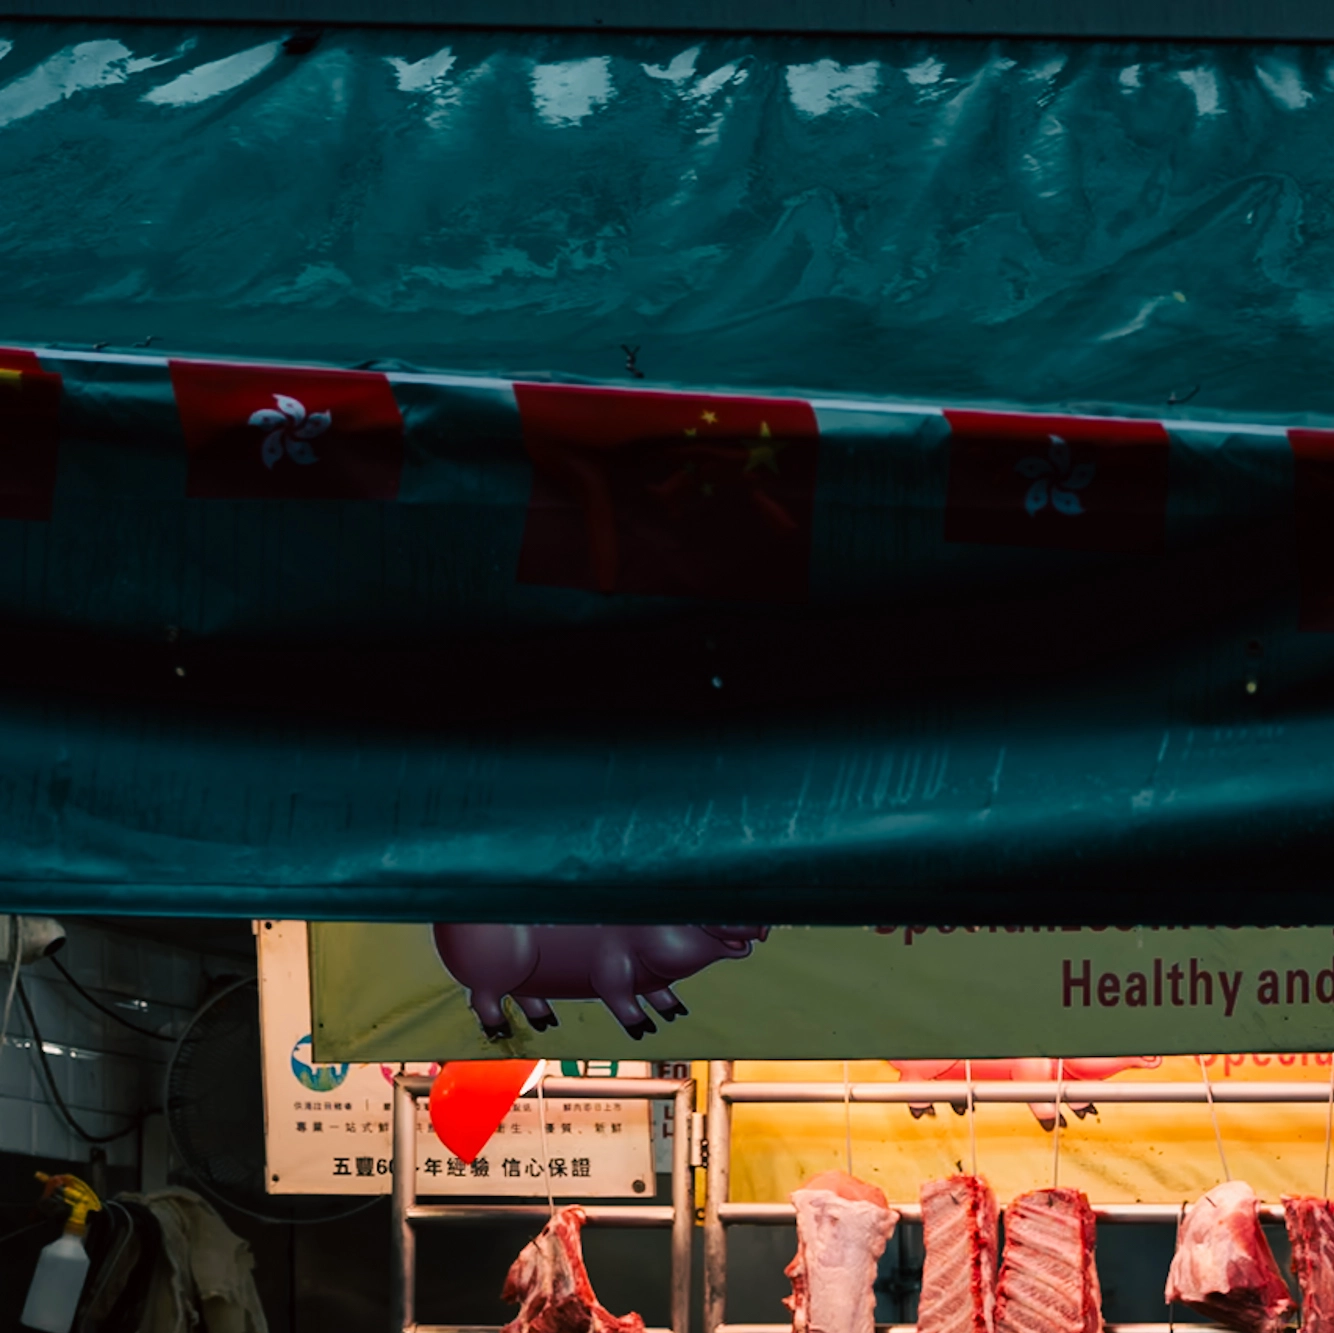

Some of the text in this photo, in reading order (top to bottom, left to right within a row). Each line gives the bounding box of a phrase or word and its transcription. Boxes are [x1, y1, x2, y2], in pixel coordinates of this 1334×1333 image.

[1061, 957, 1244, 1017] Healthy
[501, 1157, 592, 1178] 信心保證
